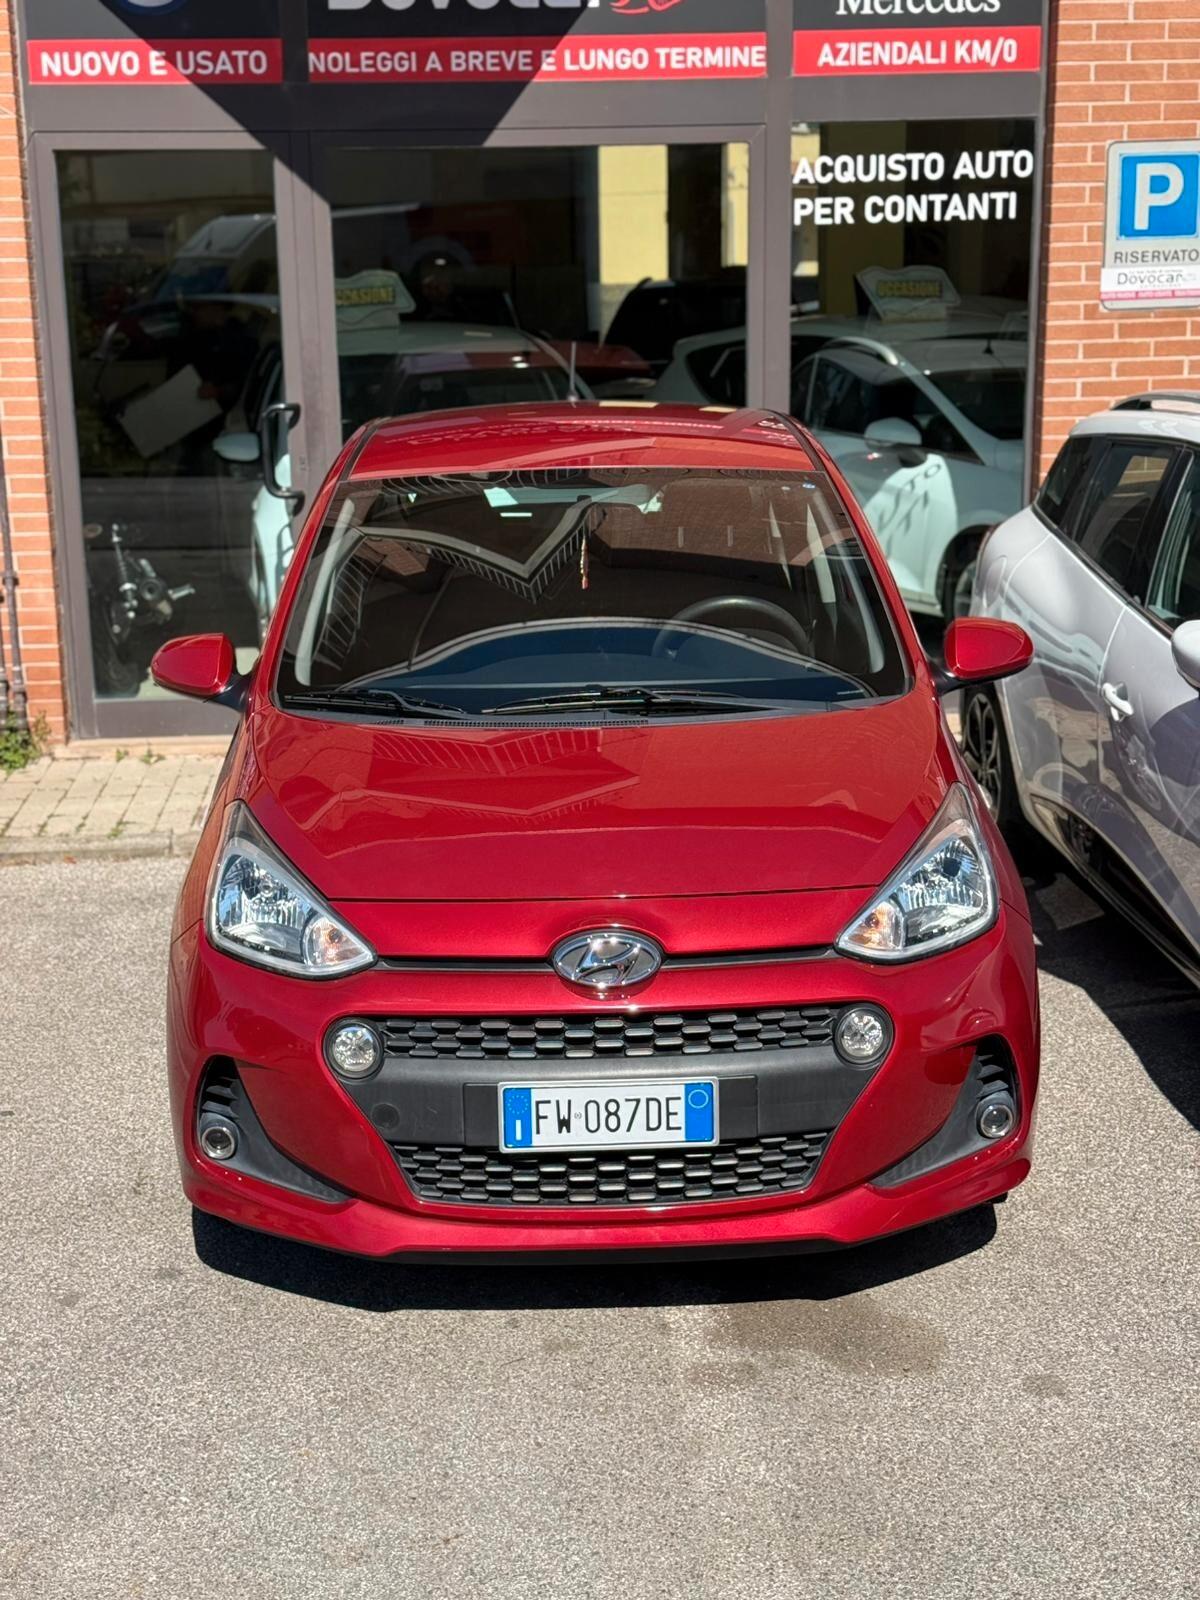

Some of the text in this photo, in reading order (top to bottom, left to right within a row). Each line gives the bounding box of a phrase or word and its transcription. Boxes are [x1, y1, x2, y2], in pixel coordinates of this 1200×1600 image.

[41, 50, 268, 76] NUOVO E USATO
[308, 45, 767, 73] NOLEGGI A BREVE E LUNGO TERMINE
[817, 37, 1017, 67] AZIENDALI KM/0
[792, 150, 1034, 184] ACQUISTO AUTO
[793, 191, 1017, 226] PER CONTANTI
[1134, 162, 1184, 230] P
[1113, 248, 1200, 264] RISERVATO
[1117, 272, 1183, 285] Dovocar
